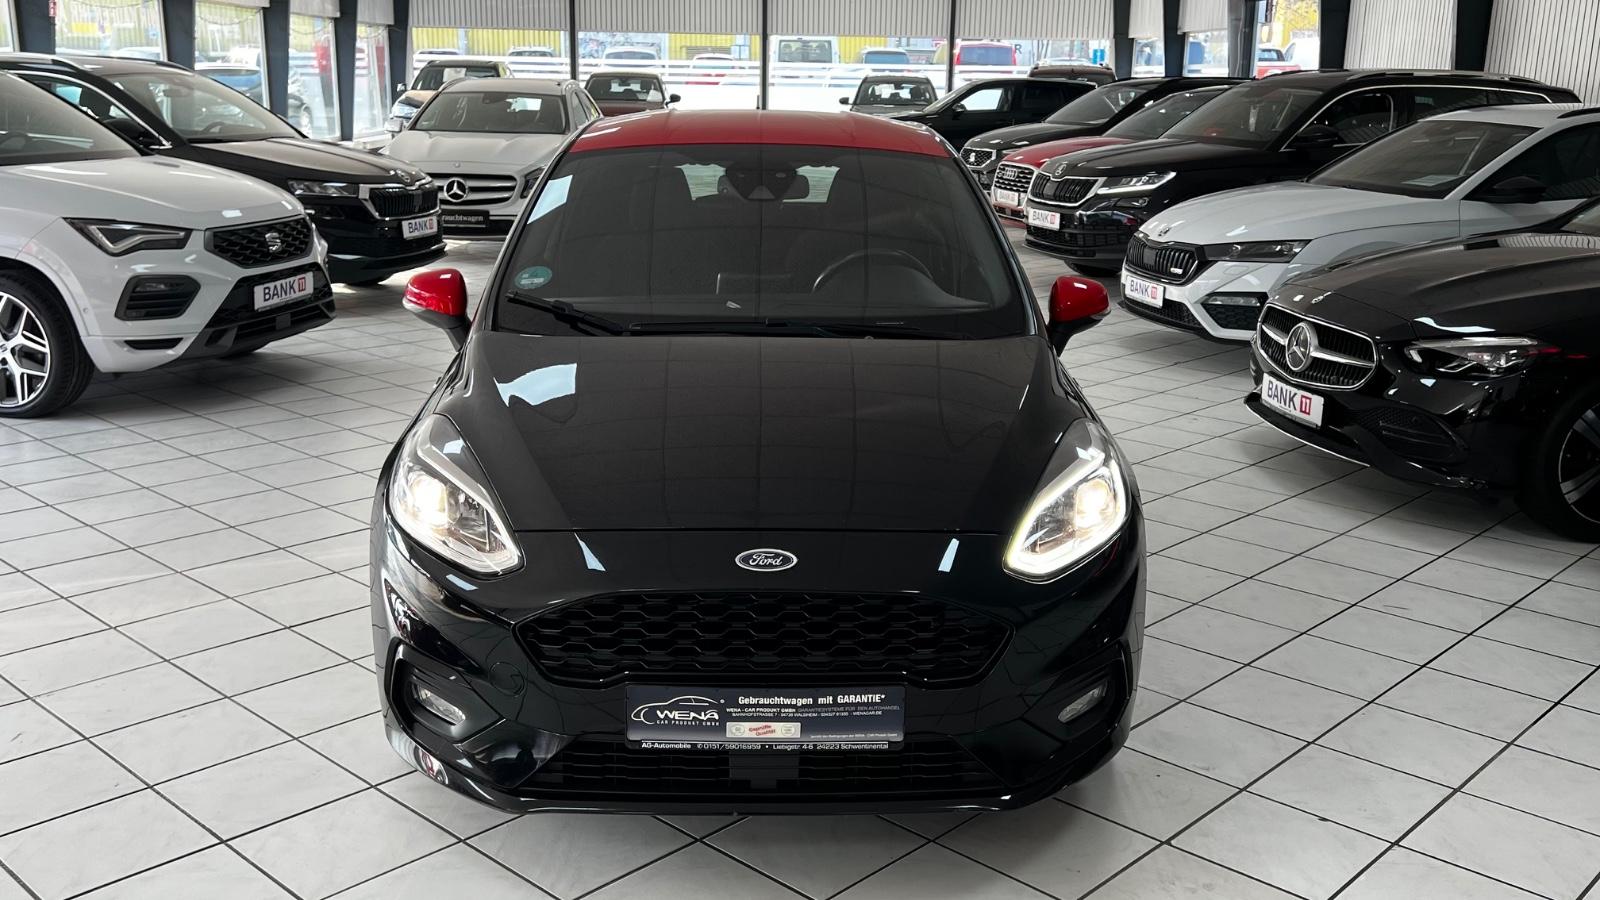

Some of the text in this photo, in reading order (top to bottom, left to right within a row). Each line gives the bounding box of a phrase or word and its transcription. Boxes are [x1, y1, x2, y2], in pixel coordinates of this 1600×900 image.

[1032, 211, 1050, 223] BANK
[408, 219, 428, 233] BANK
[263, 279, 297, 302] BANK
[1130, 280, 1150, 297] BANK
[1267, 380, 1298, 410] BANK
[749, 552, 783, 565] Ford
[738, 696, 813, 706] Gebrauchtwagen
[818, 696, 833, 704] mit
[656, 709, 719, 720] WENA
